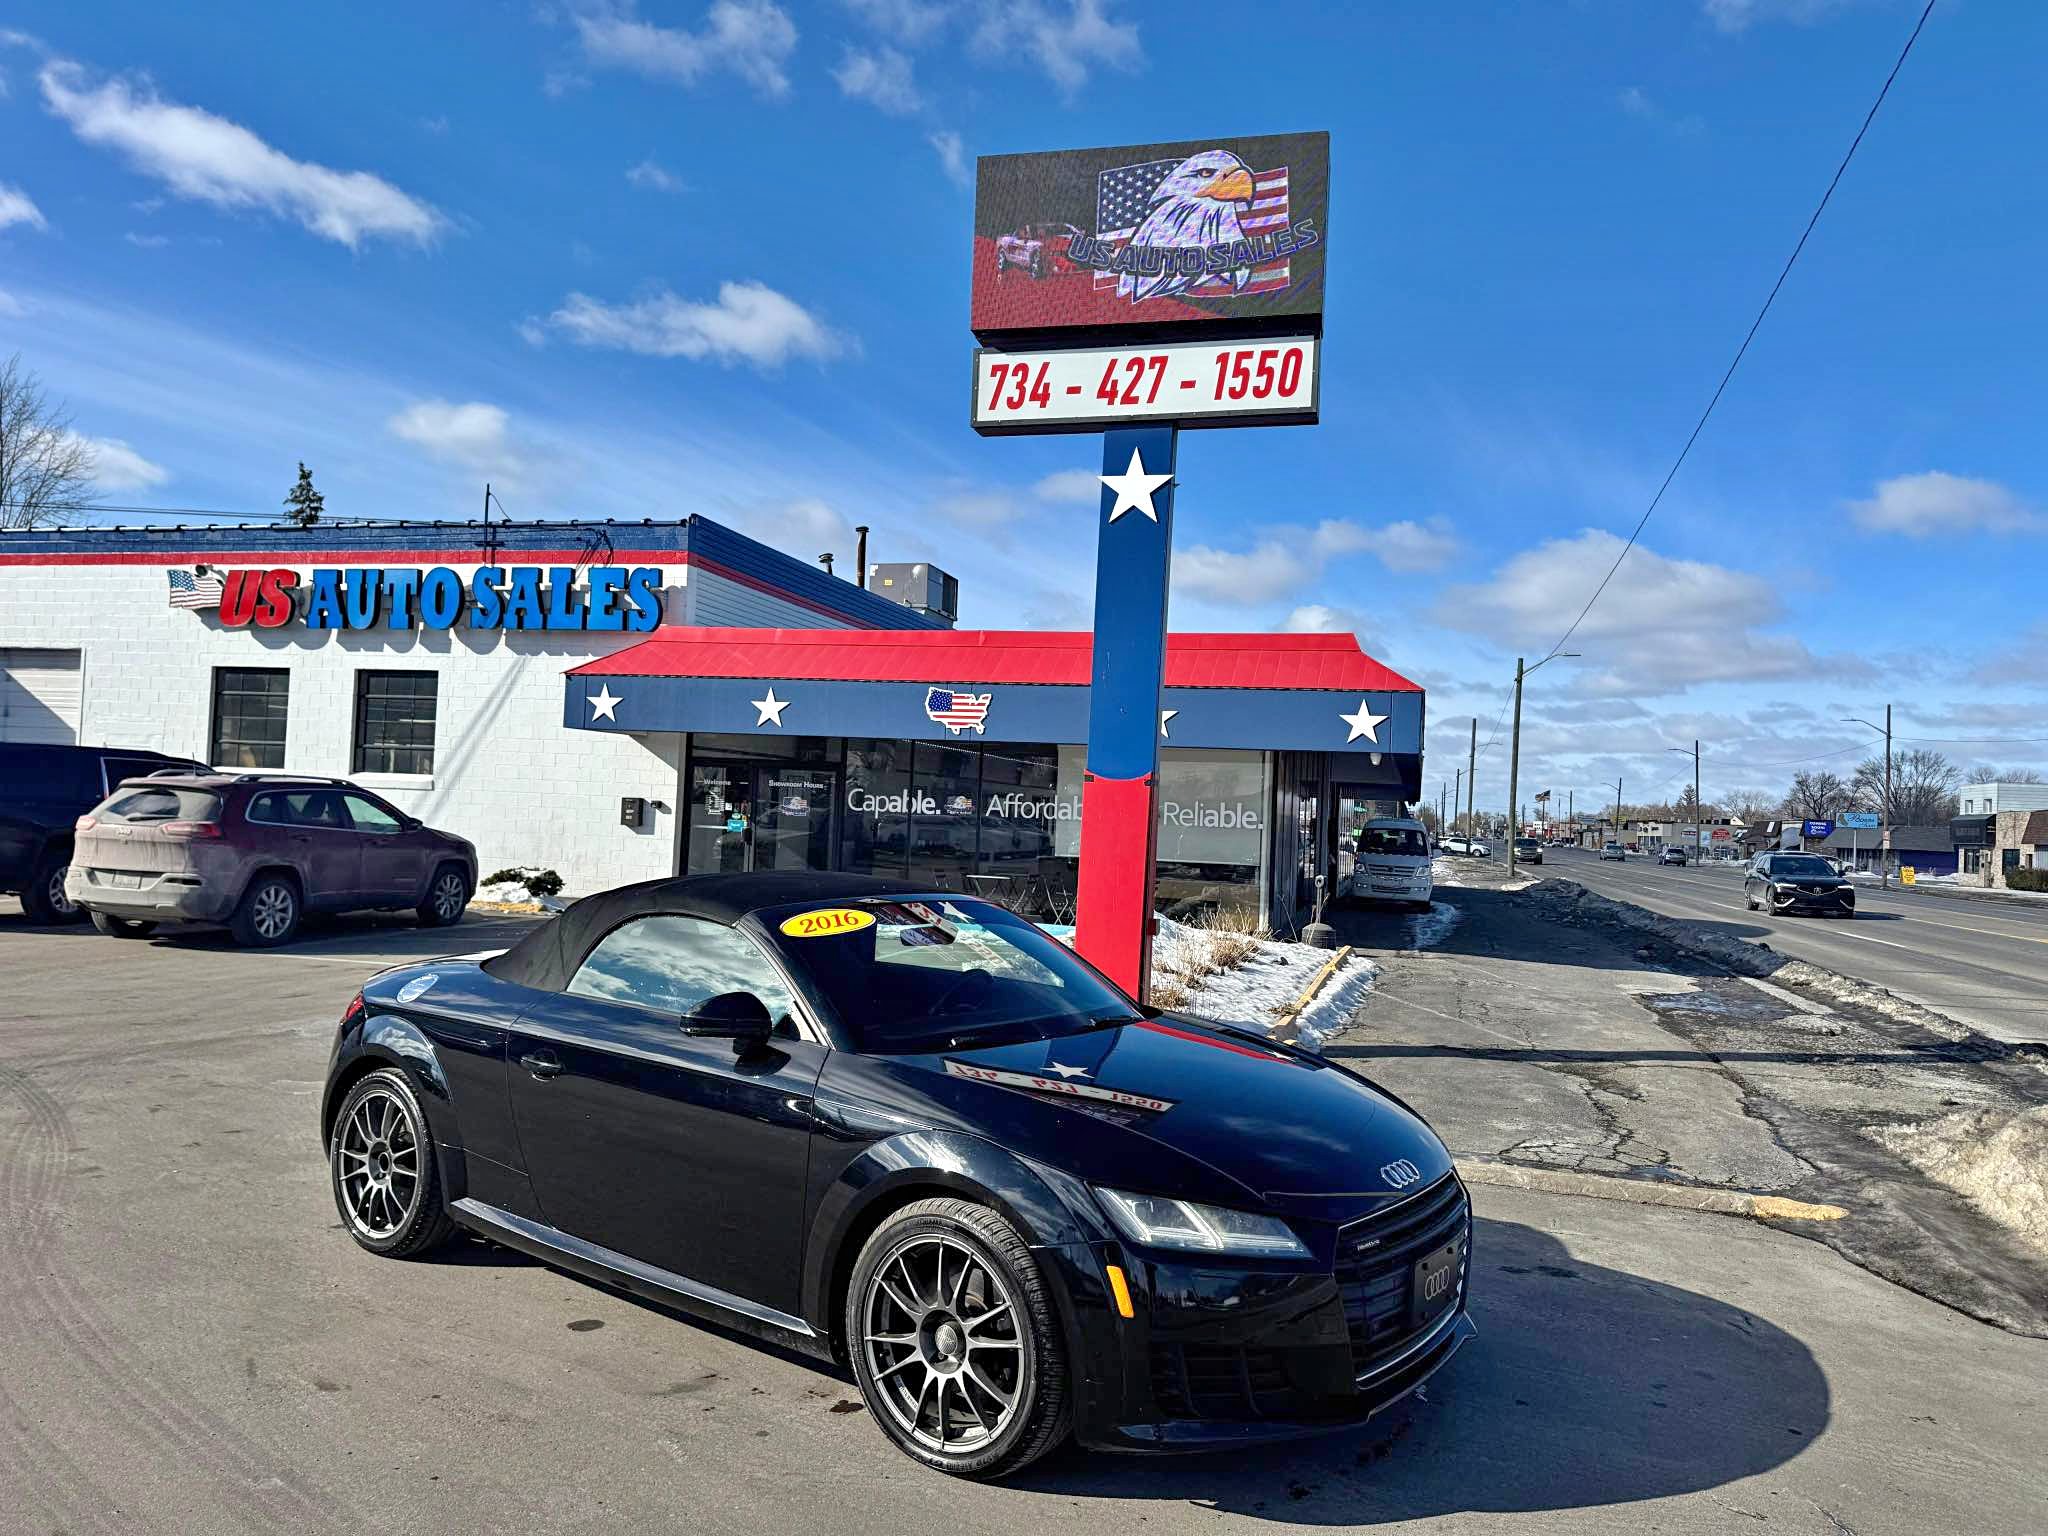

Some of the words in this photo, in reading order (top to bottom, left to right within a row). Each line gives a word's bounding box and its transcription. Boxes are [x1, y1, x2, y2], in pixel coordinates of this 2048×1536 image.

[988, 361, 1051, 411] 734
[1096, 355, 1169, 406] 427
[1213, 347, 1304, 401] 1550
[218, 568, 299, 629] US
[304, 566, 464, 631] AUTO
[469, 565, 663, 633] SALES
[847, 787, 941, 819] Capable.
[1163, 800, 1264, 830] Reliable.
[799, 911, 860, 934] 2016
